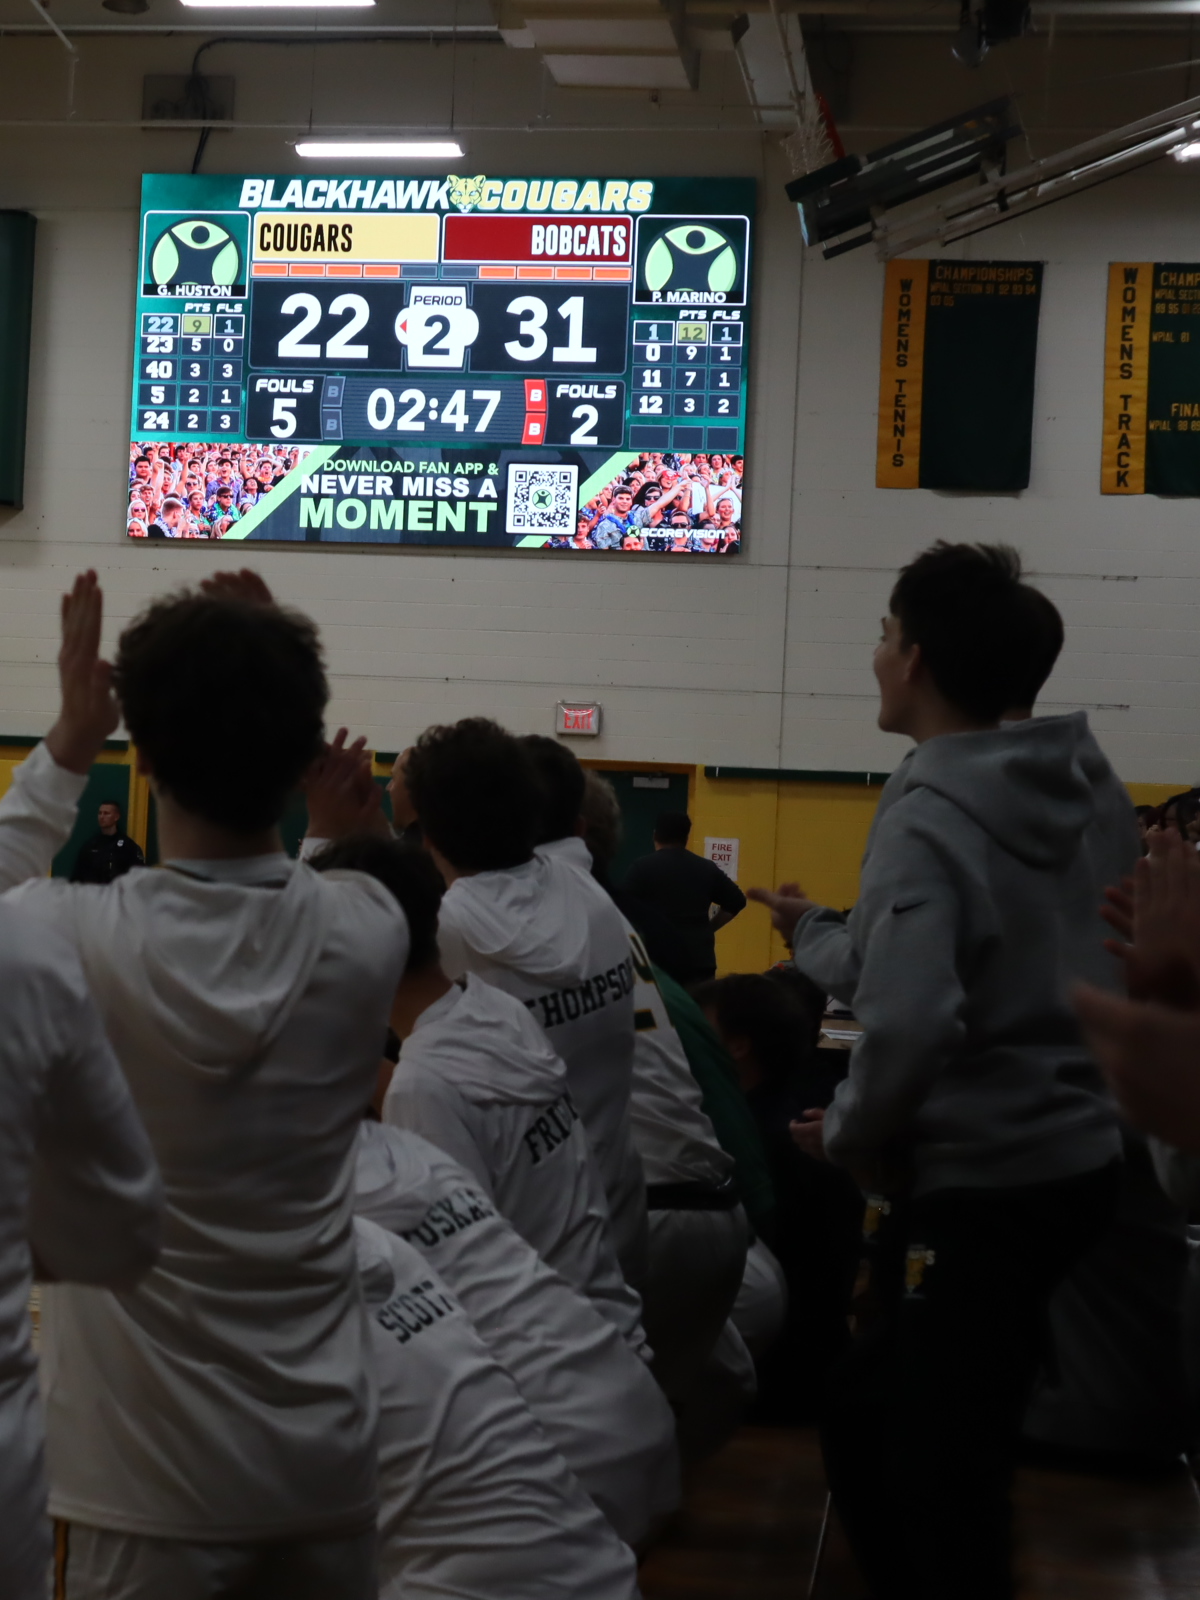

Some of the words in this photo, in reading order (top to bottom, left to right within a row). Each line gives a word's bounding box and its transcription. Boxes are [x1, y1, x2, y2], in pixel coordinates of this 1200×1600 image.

[238, 178, 449, 210] BLACKHAWK
[477, 180, 654, 212] COUGARS
[259, 222, 353, 252] COUGARS
[531, 224, 627, 256] BOBCATS
[935, 265, 1034, 282] CHAMPIONSHIPS
[157, 285, 171, 297] G.
[175, 285, 232, 297] HUSTON
[652, 291, 663, 303] P.
[666, 291, 727, 304] MARINO
[184, 302, 211, 313] PTS
[216, 303, 243, 313] FLS
[413, 295, 463, 306] PERIOD
[679, 310, 707, 320] PTS
[712, 310, 741, 320] FLS
[896, 278, 912, 367] WOMENS
[1119, 267, 1138, 380] WOMENS
[147, 316, 174, 333] 22
[192, 319, 202, 332] 9
[224, 319, 234, 333] 1
[277, 292, 371, 358] 22
[504, 295, 597, 362] 31
[649, 323, 659, 341] 1
[681, 327, 704, 341] 12
[720, 327, 732, 341] 1
[422, 314, 451, 356] 2
[146, 336, 174, 353] 23
[191, 337, 202, 352] 5
[223, 338, 234, 352] 0
[645, 344, 661, 361] 0
[686, 346, 697, 360] 9
[720, 346, 731, 361] 1
[145, 360, 173, 378] 40
[189, 363, 201, 377] 3
[222, 363, 233, 378] 3
[255, 379, 314, 393] FOULS
[642, 369, 662, 388] 11
[685, 371, 697, 387] 7
[718, 372, 730, 387] 1
[150, 386, 165, 404] 5
[188, 388, 200, 403] 2
[220, 389, 232, 403] 1
[327, 386, 339, 397] B
[530, 389, 542, 402] B
[556, 384, 617, 399] FOULS
[367, 388, 502, 433] 02:47
[639, 395, 663, 414] 12
[684, 398, 695, 412] 3
[718, 399, 730, 413] 2
[143, 411, 170, 430] 24
[187, 414, 199, 428] 2
[220, 415, 231, 429] 3
[269, 398, 297, 438] 5
[325, 419, 337, 431] B
[570, 404, 599, 446] 2
[892, 379, 907, 468] TENNIS
[528, 422, 541, 436] B
[1116, 394, 1133, 488] TRACK
[324, 459, 415, 474] DOWNLOAD
[419, 461, 450, 474] FAN
[454, 462, 484, 475] APP
[487, 465, 499, 476] &
[300, 474, 394, 495] NEVER
[402, 476, 470, 498] MISS
[478, 478, 498, 498] A
[299, 498, 498, 533] MOMENT
[640, 527, 726, 540] SCOREVISION
[564, 708, 593, 729] EXIT
[712, 843, 732, 852] FIRE
[711, 853, 732, 862] EXIT
[523, 956, 634, 1028] HOMPSO
